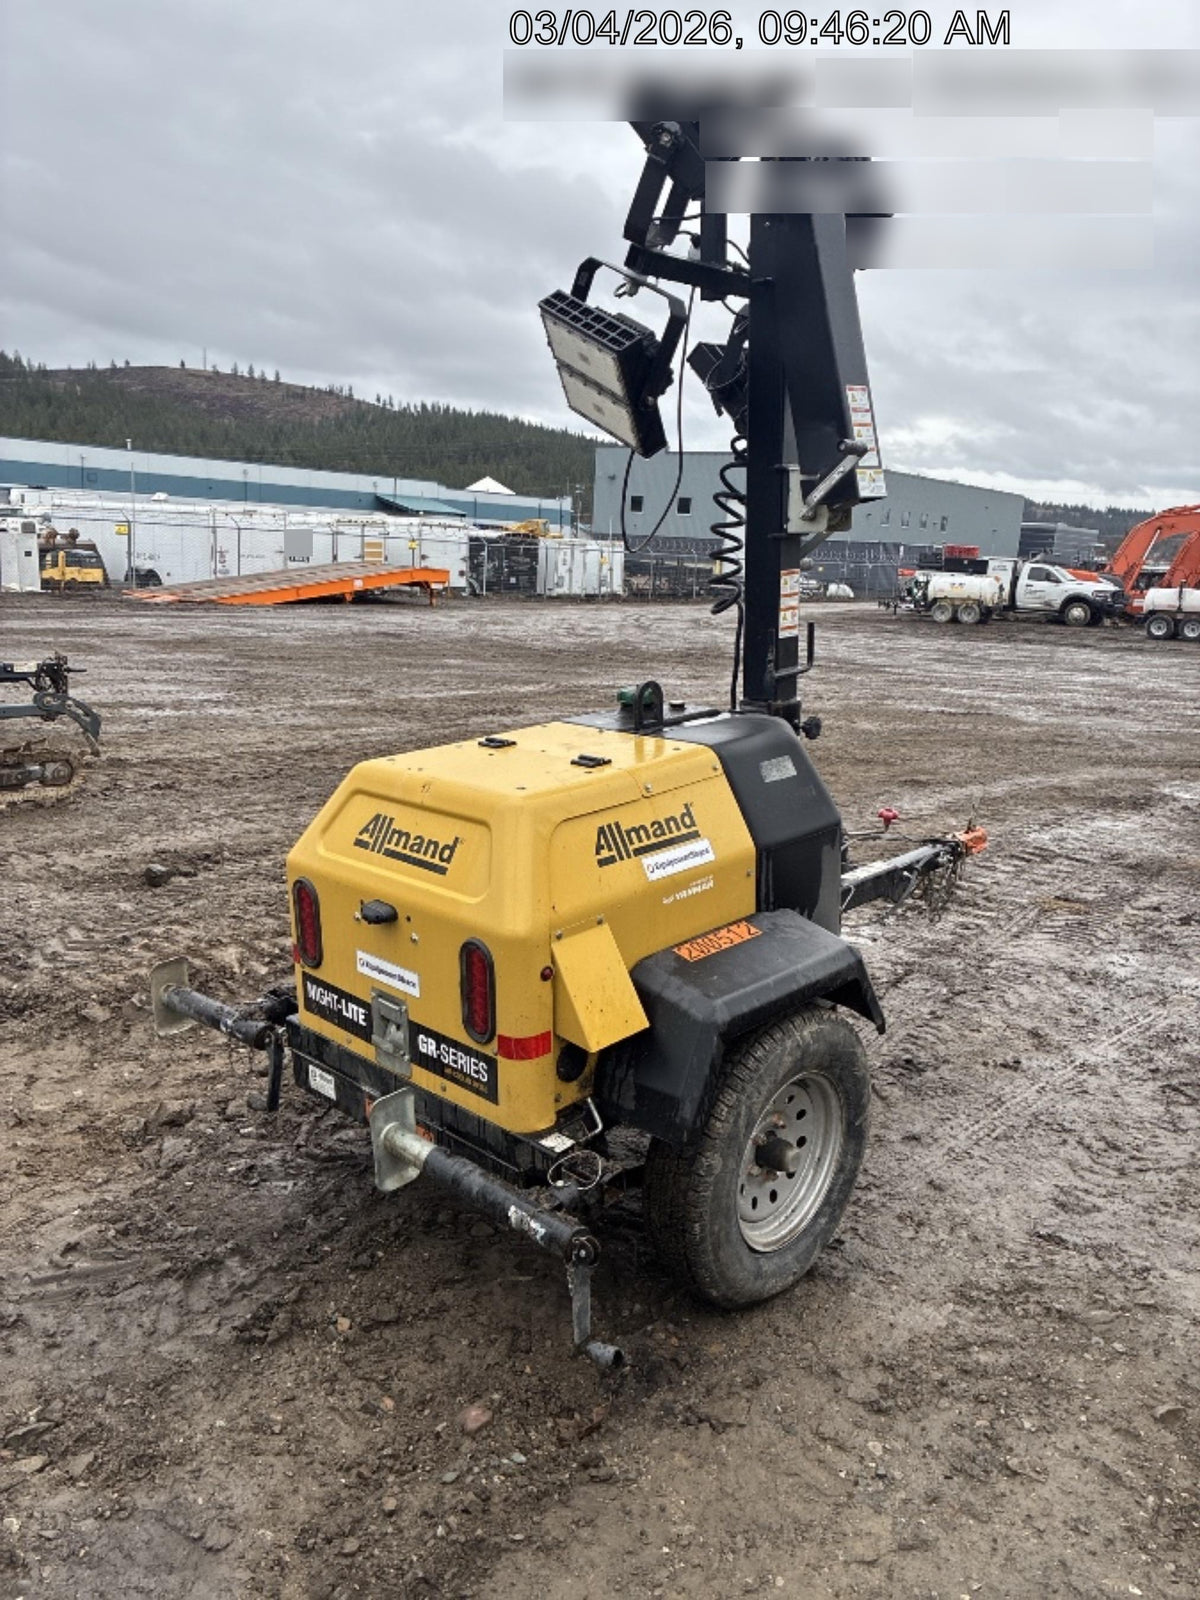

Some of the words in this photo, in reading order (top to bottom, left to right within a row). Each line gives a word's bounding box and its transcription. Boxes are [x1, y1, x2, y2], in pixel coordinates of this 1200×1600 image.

[357, 812, 460, 865] Allmand
[594, 801, 697, 862] Allmand
[417, 1033, 489, 1082] GR-SERIES
